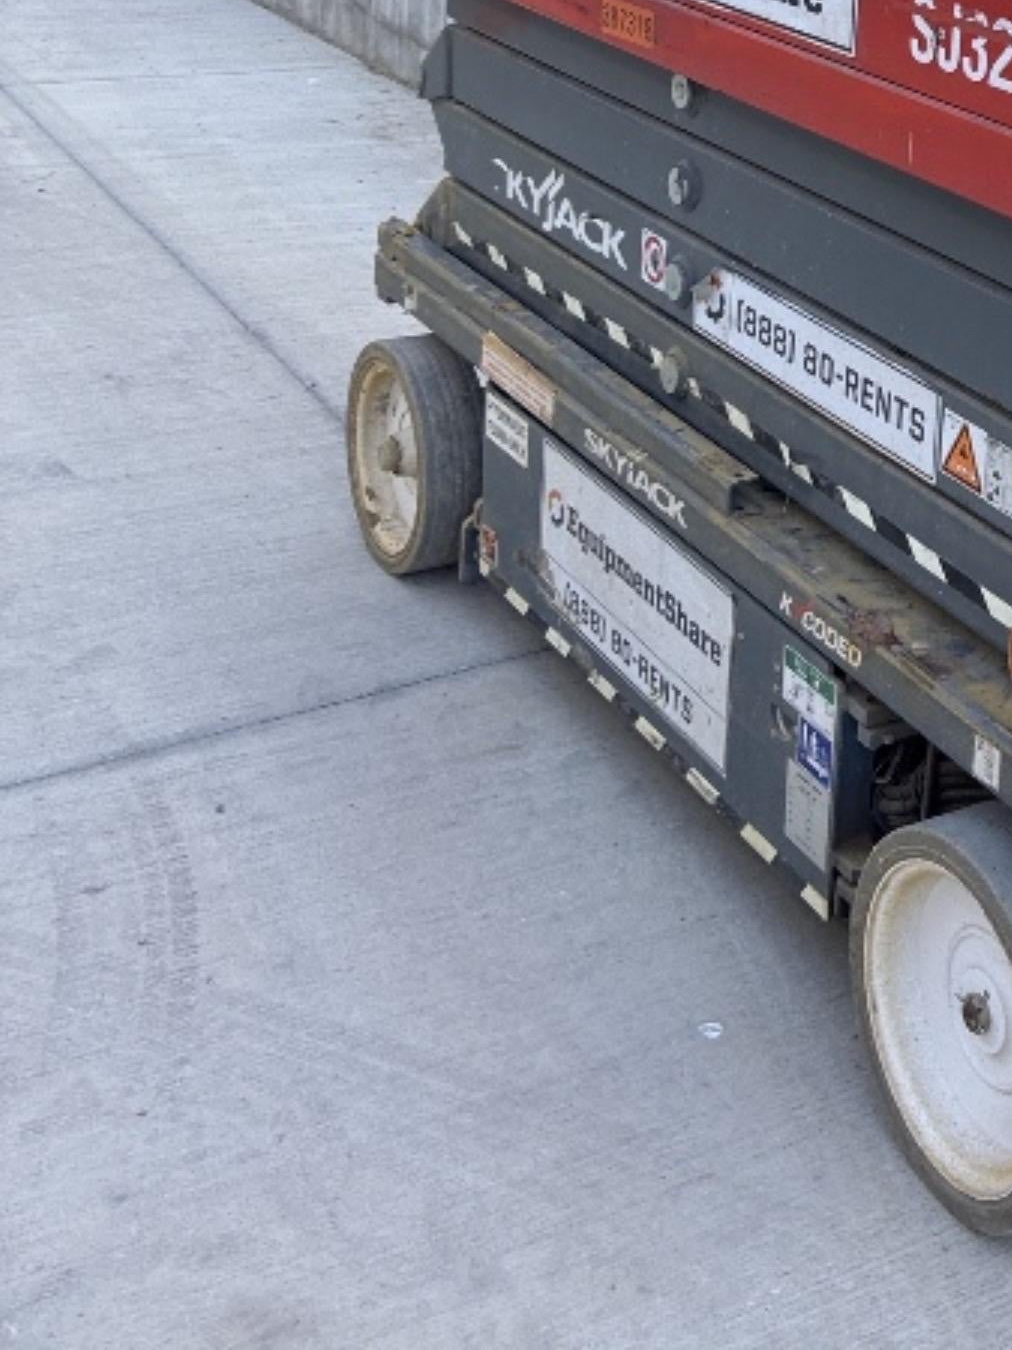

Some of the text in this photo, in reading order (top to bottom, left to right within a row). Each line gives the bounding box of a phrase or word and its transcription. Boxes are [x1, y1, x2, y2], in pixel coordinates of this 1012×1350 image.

[492, 158, 628, 271] KYJACK
[737, 299, 925, 444] (888) 80-RENTS
[566, 506, 722, 666] EquipmentShare
